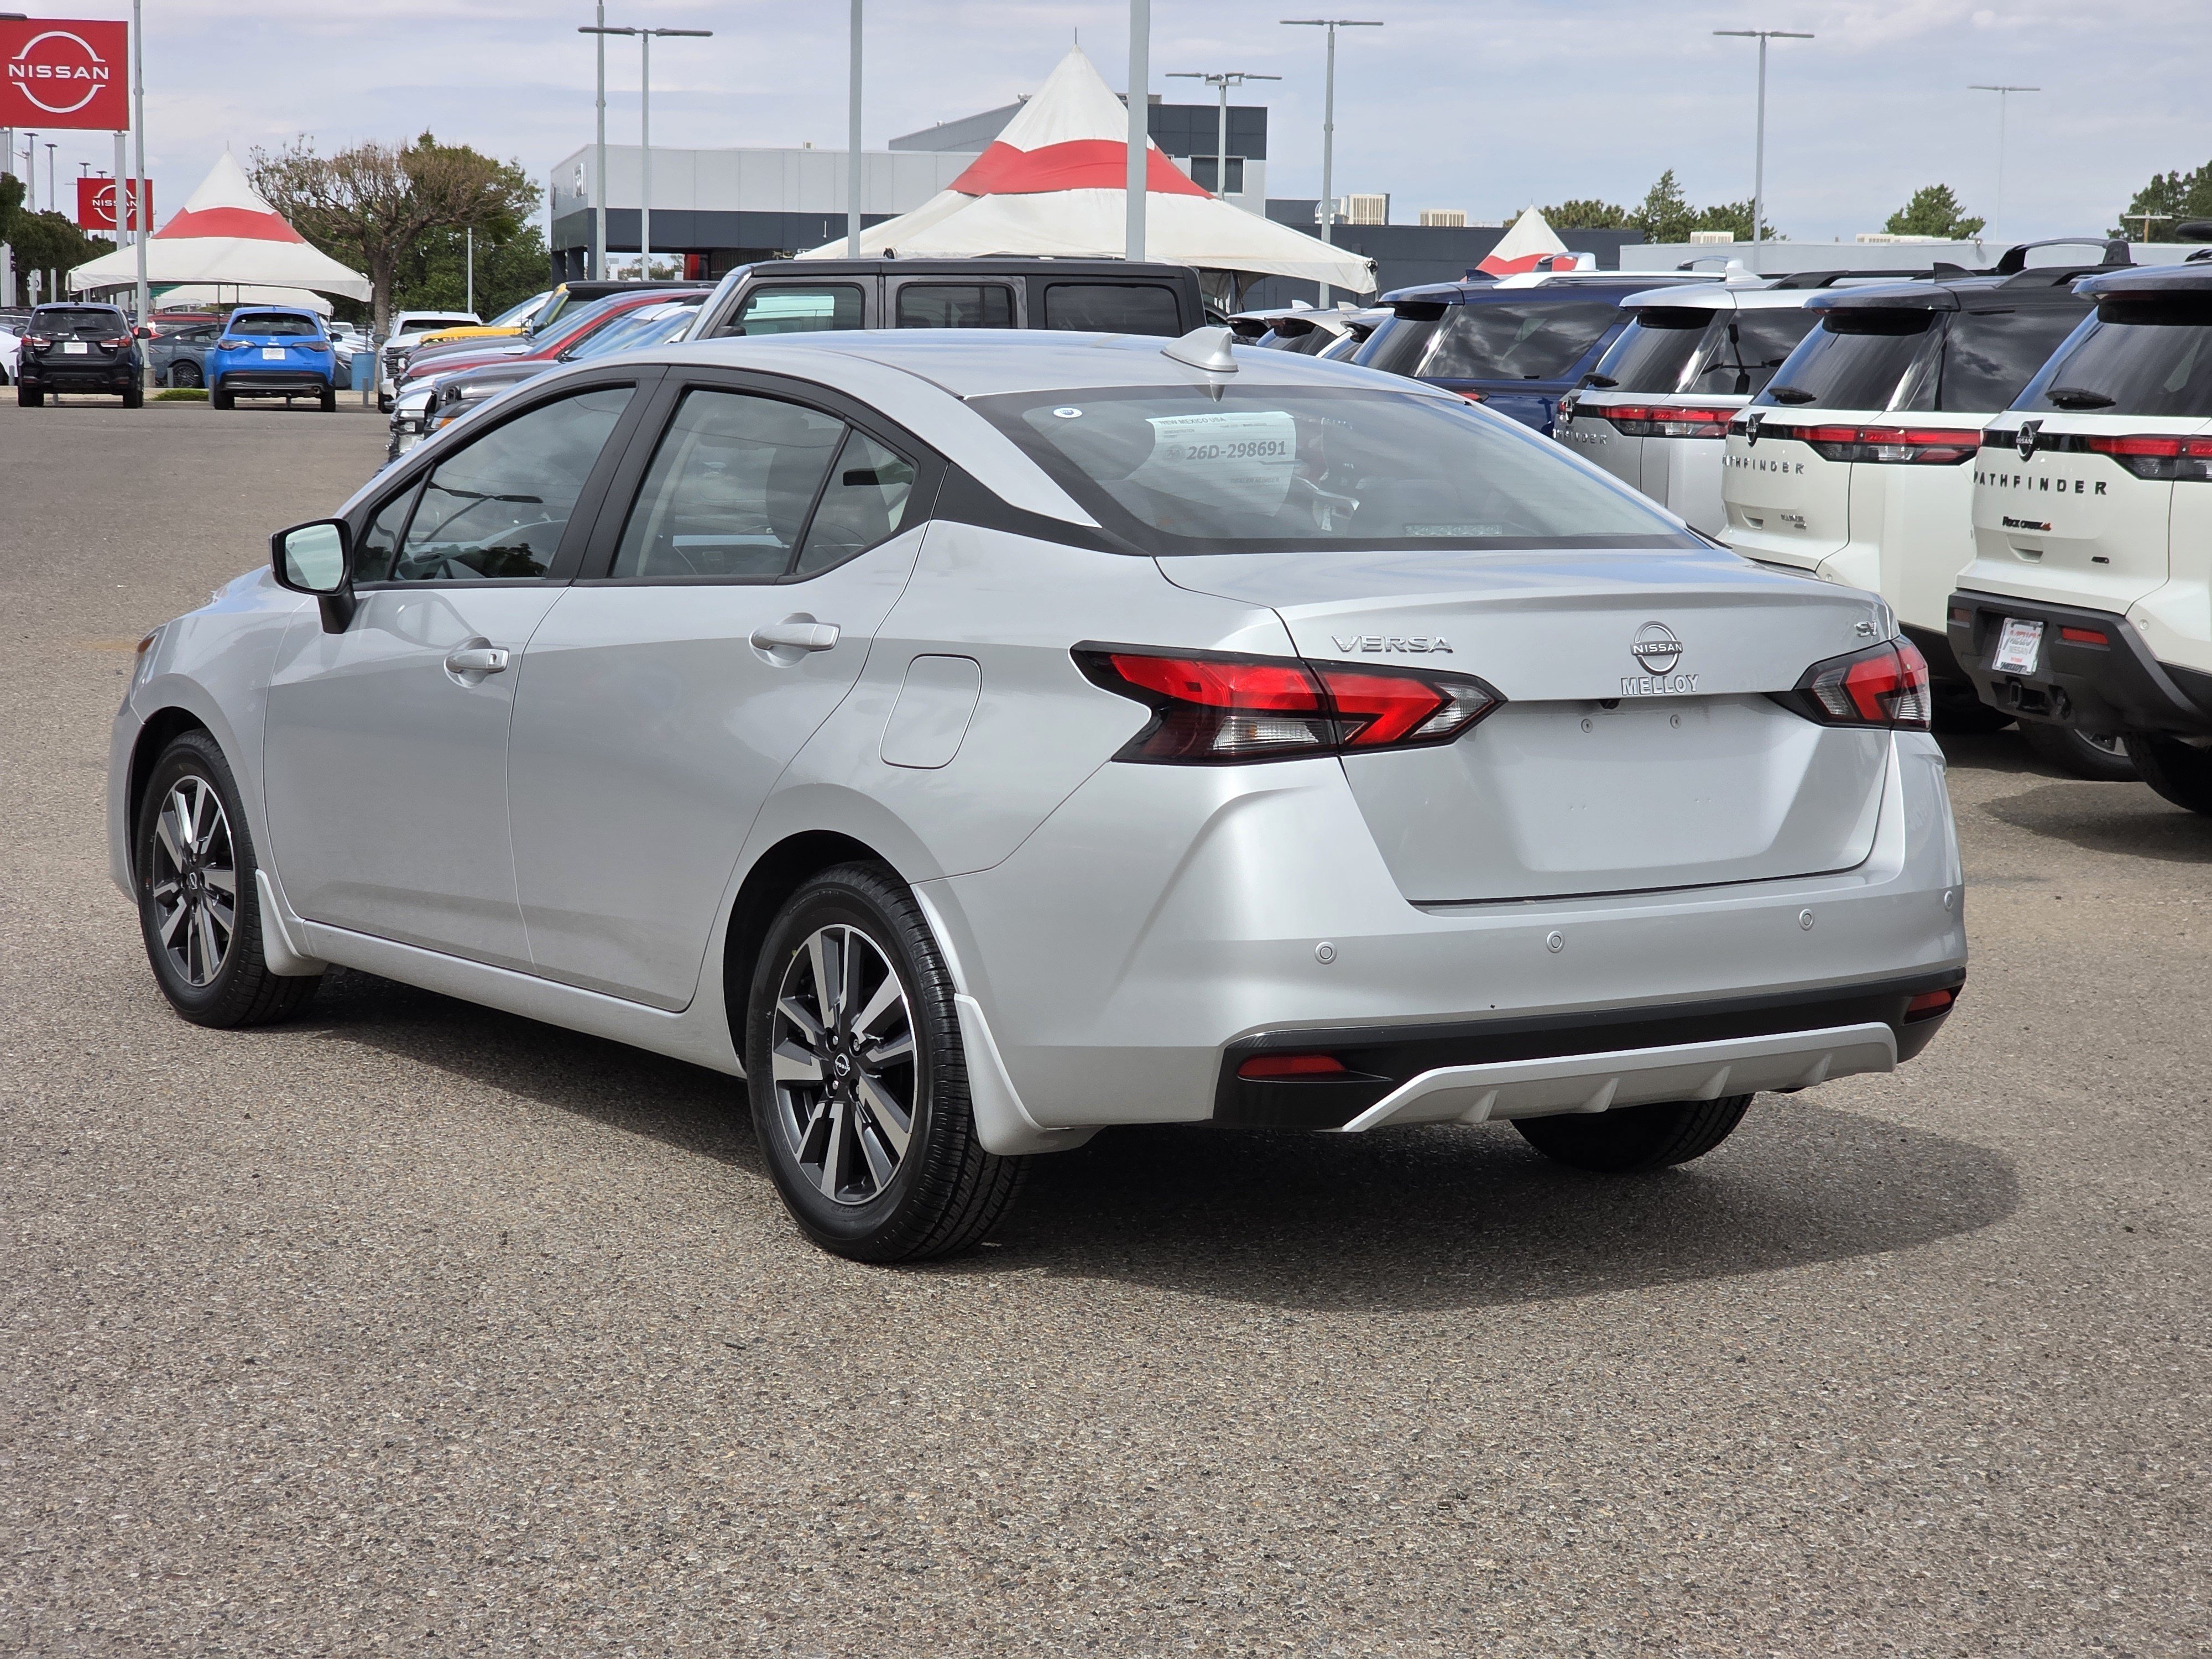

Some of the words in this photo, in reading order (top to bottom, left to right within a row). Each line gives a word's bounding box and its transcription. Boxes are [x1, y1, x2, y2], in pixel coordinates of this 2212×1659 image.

[8, 64, 109, 80] NISSAN
[1186, 441, 1286, 460] 26D-298691
[1973, 471, 2107, 495] PATHFINDER
[1331, 635, 1454, 653] VERSA
[1633, 643, 1682, 654] NISSAN
[1621, 674, 1699, 696] MELLOY
